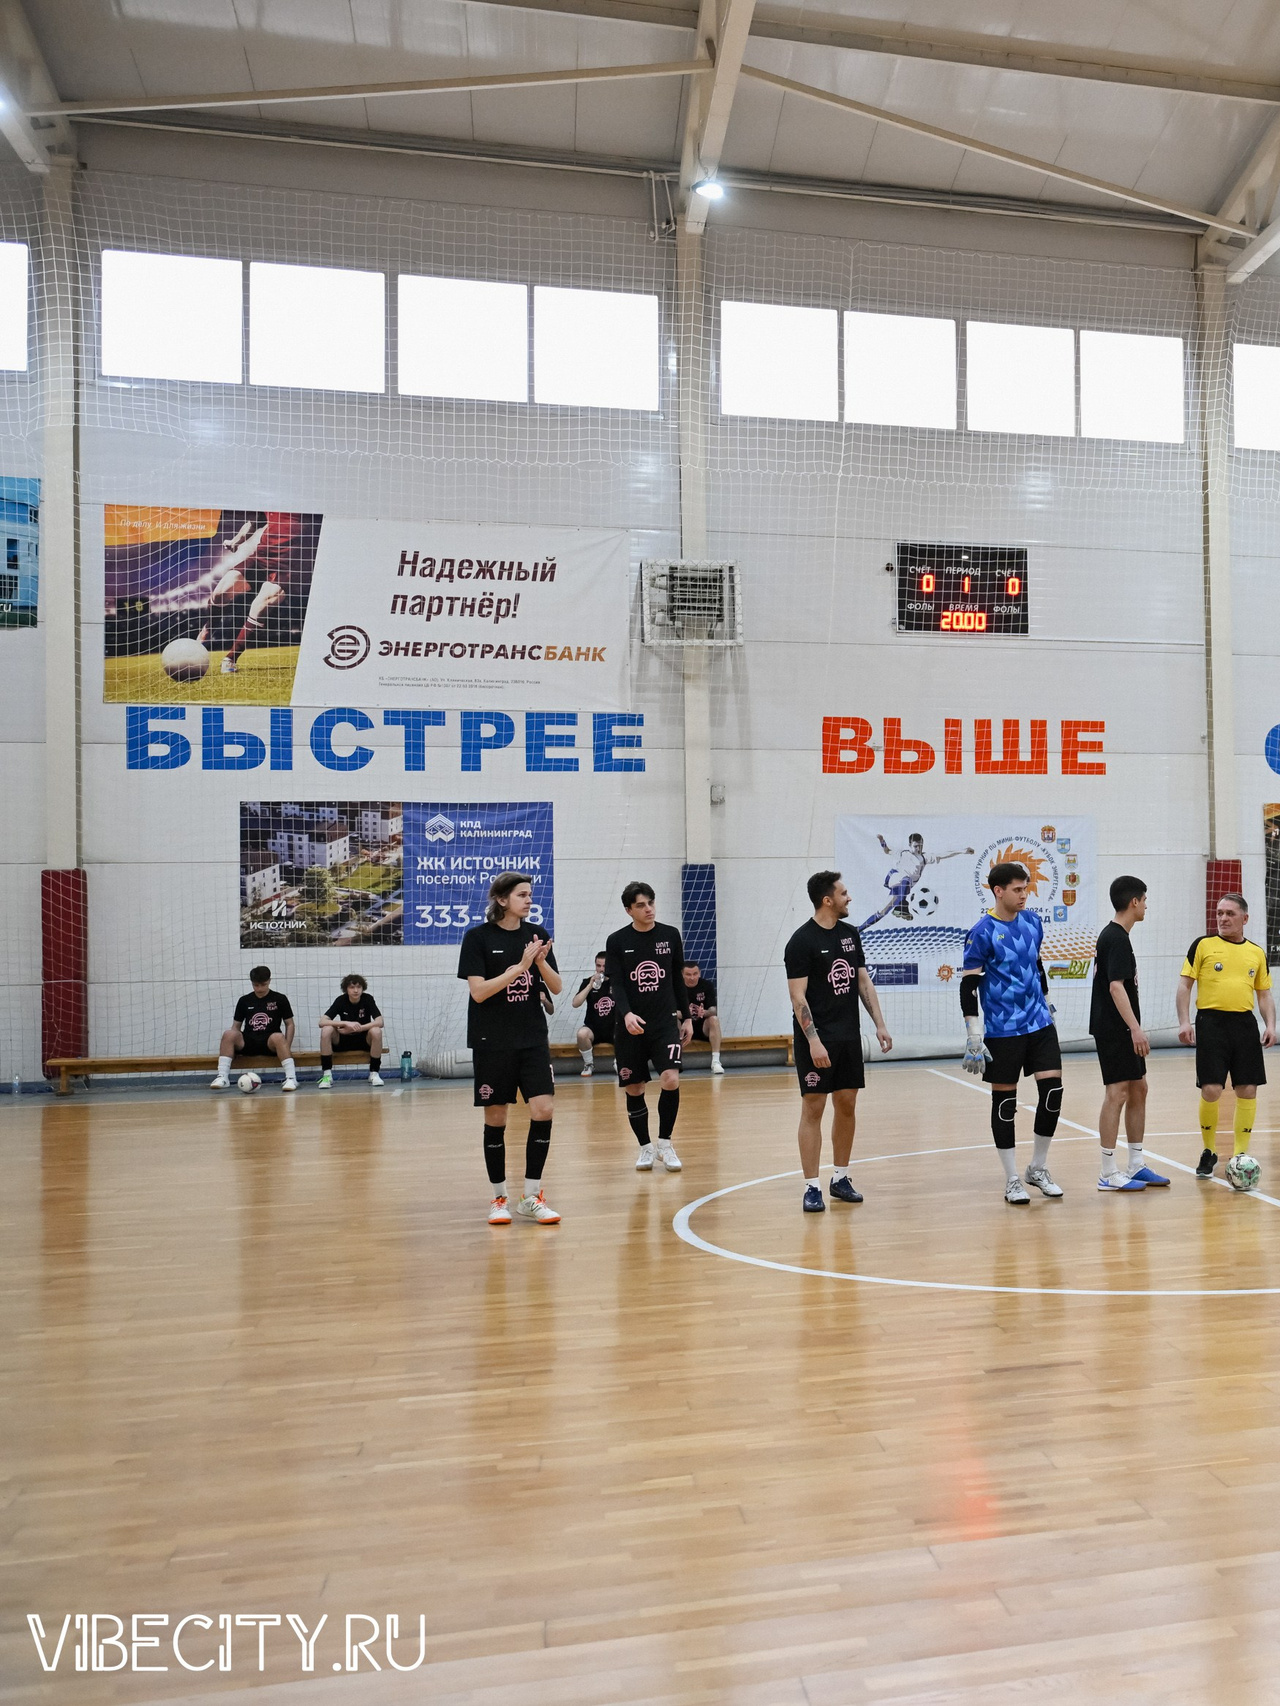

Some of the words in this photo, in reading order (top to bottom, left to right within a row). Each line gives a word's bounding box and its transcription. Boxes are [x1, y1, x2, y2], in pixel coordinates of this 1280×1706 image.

[397, 550, 557, 583] Надежный
[945, 567, 981, 576] ПЕРИОД
[922, 574, 934, 592] 0
[964, 576, 970, 593] 1
[1008, 578, 1019, 595] 0
[390, 592, 520, 624] партнёр!
[907, 603, 935, 611] ФОЛЫ
[949, 604, 979, 612] ВРЕМЯ
[993, 605, 1021, 614] ФОЛЫ
[378, 640, 607, 662] ЭНЕРГОТРАНСБАНК
[126, 707, 646, 772] БЫСТРЕЕ
[822, 716, 1106, 775] ВЫШЕ
[460, 821, 482, 829] КПД
[460, 830, 533, 838] КАЛИНИНГРАД
[417, 857, 445, 870] ЖК
[451, 857, 541, 870] ИСТОЧНИК
[975, 849, 989, 871] ТУРНИР
[417, 874, 476, 884] поселок
[639, 985, 659, 993] UNIT
[834, 986, 851, 995] UNIT
[507, 994, 529, 1002] UNIT
